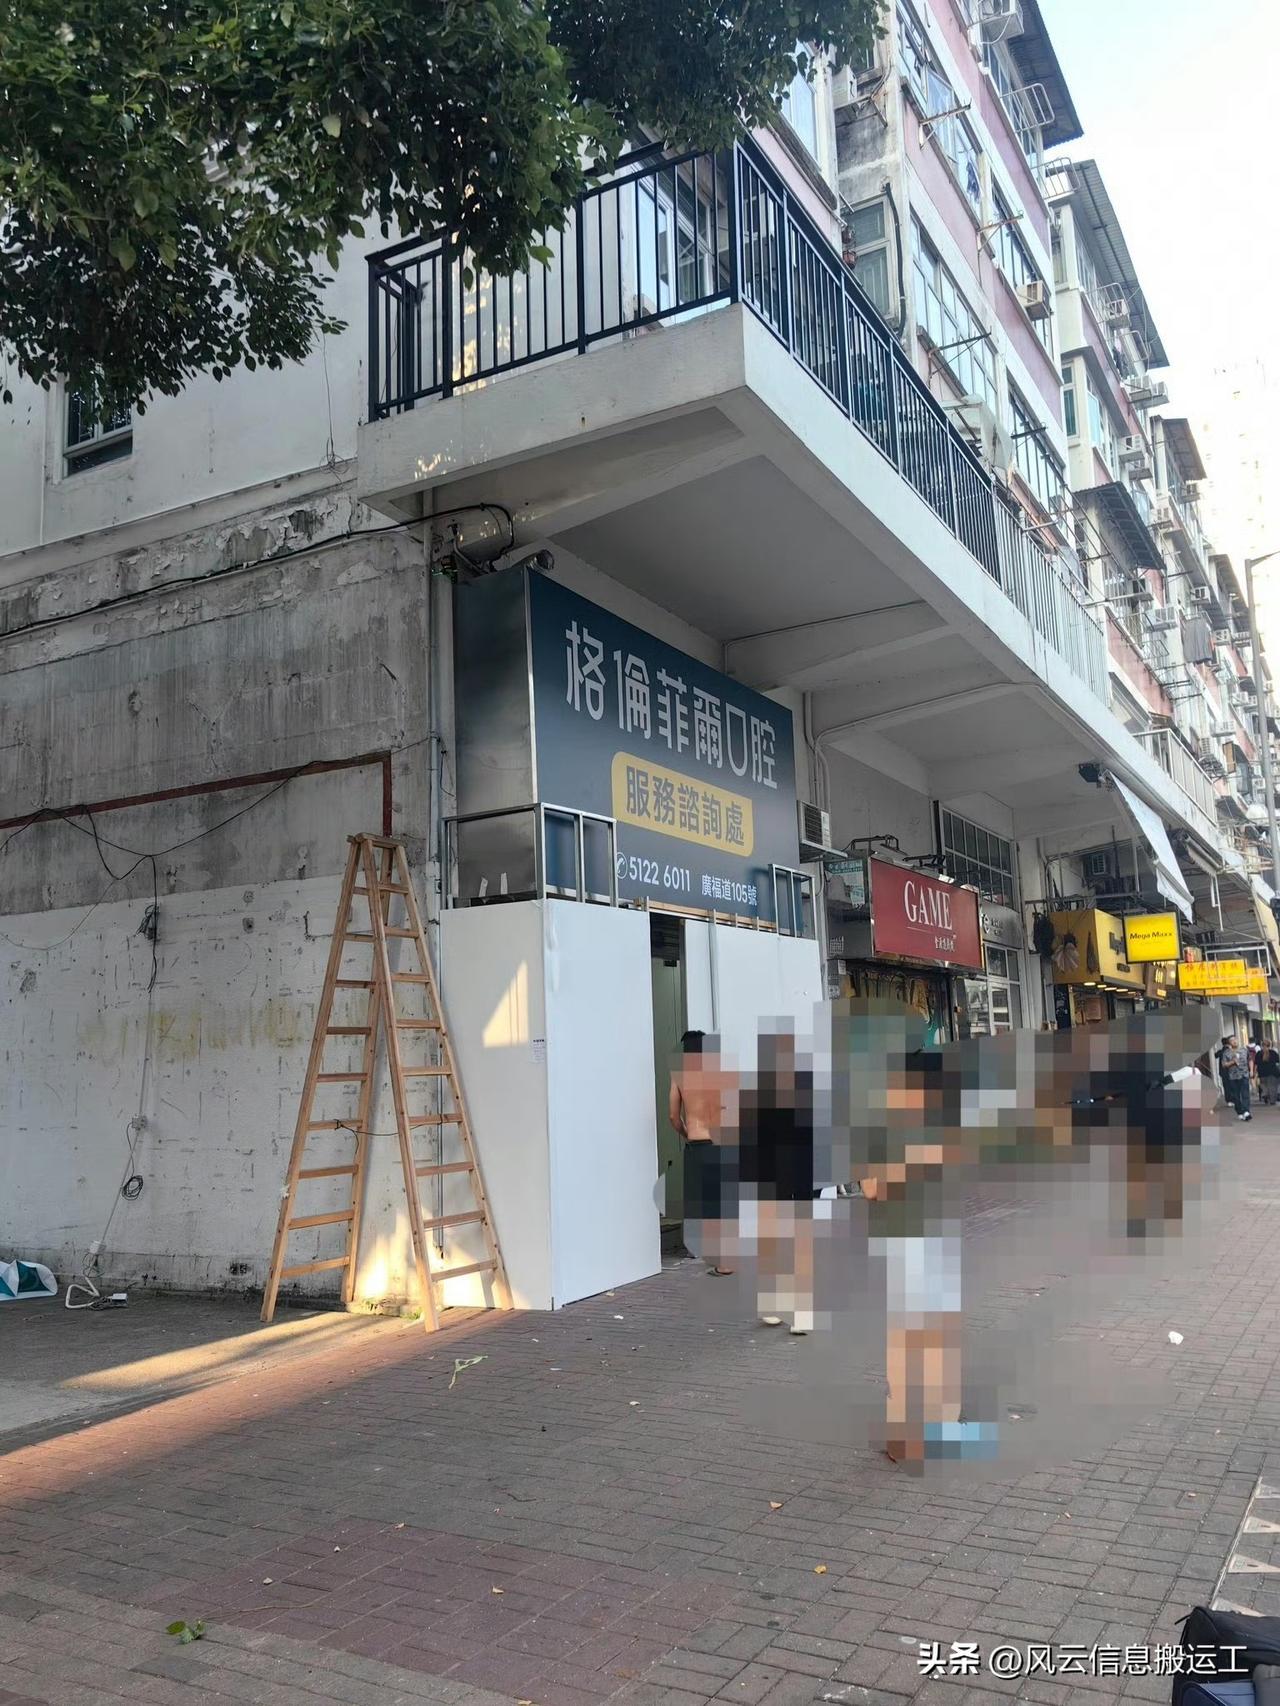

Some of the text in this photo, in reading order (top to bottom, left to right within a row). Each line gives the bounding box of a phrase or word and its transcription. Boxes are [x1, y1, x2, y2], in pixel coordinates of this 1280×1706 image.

[565, 620, 778, 790] 格倫菲爾口腔
[626, 765, 745, 847] 服務諮詢處
[629, 856, 690, 892] 5122 6011
[701, 873, 758, 907] 廣福道105號
[903, 880, 953, 931] GAME
[1129, 932, 1151, 940] Mega
